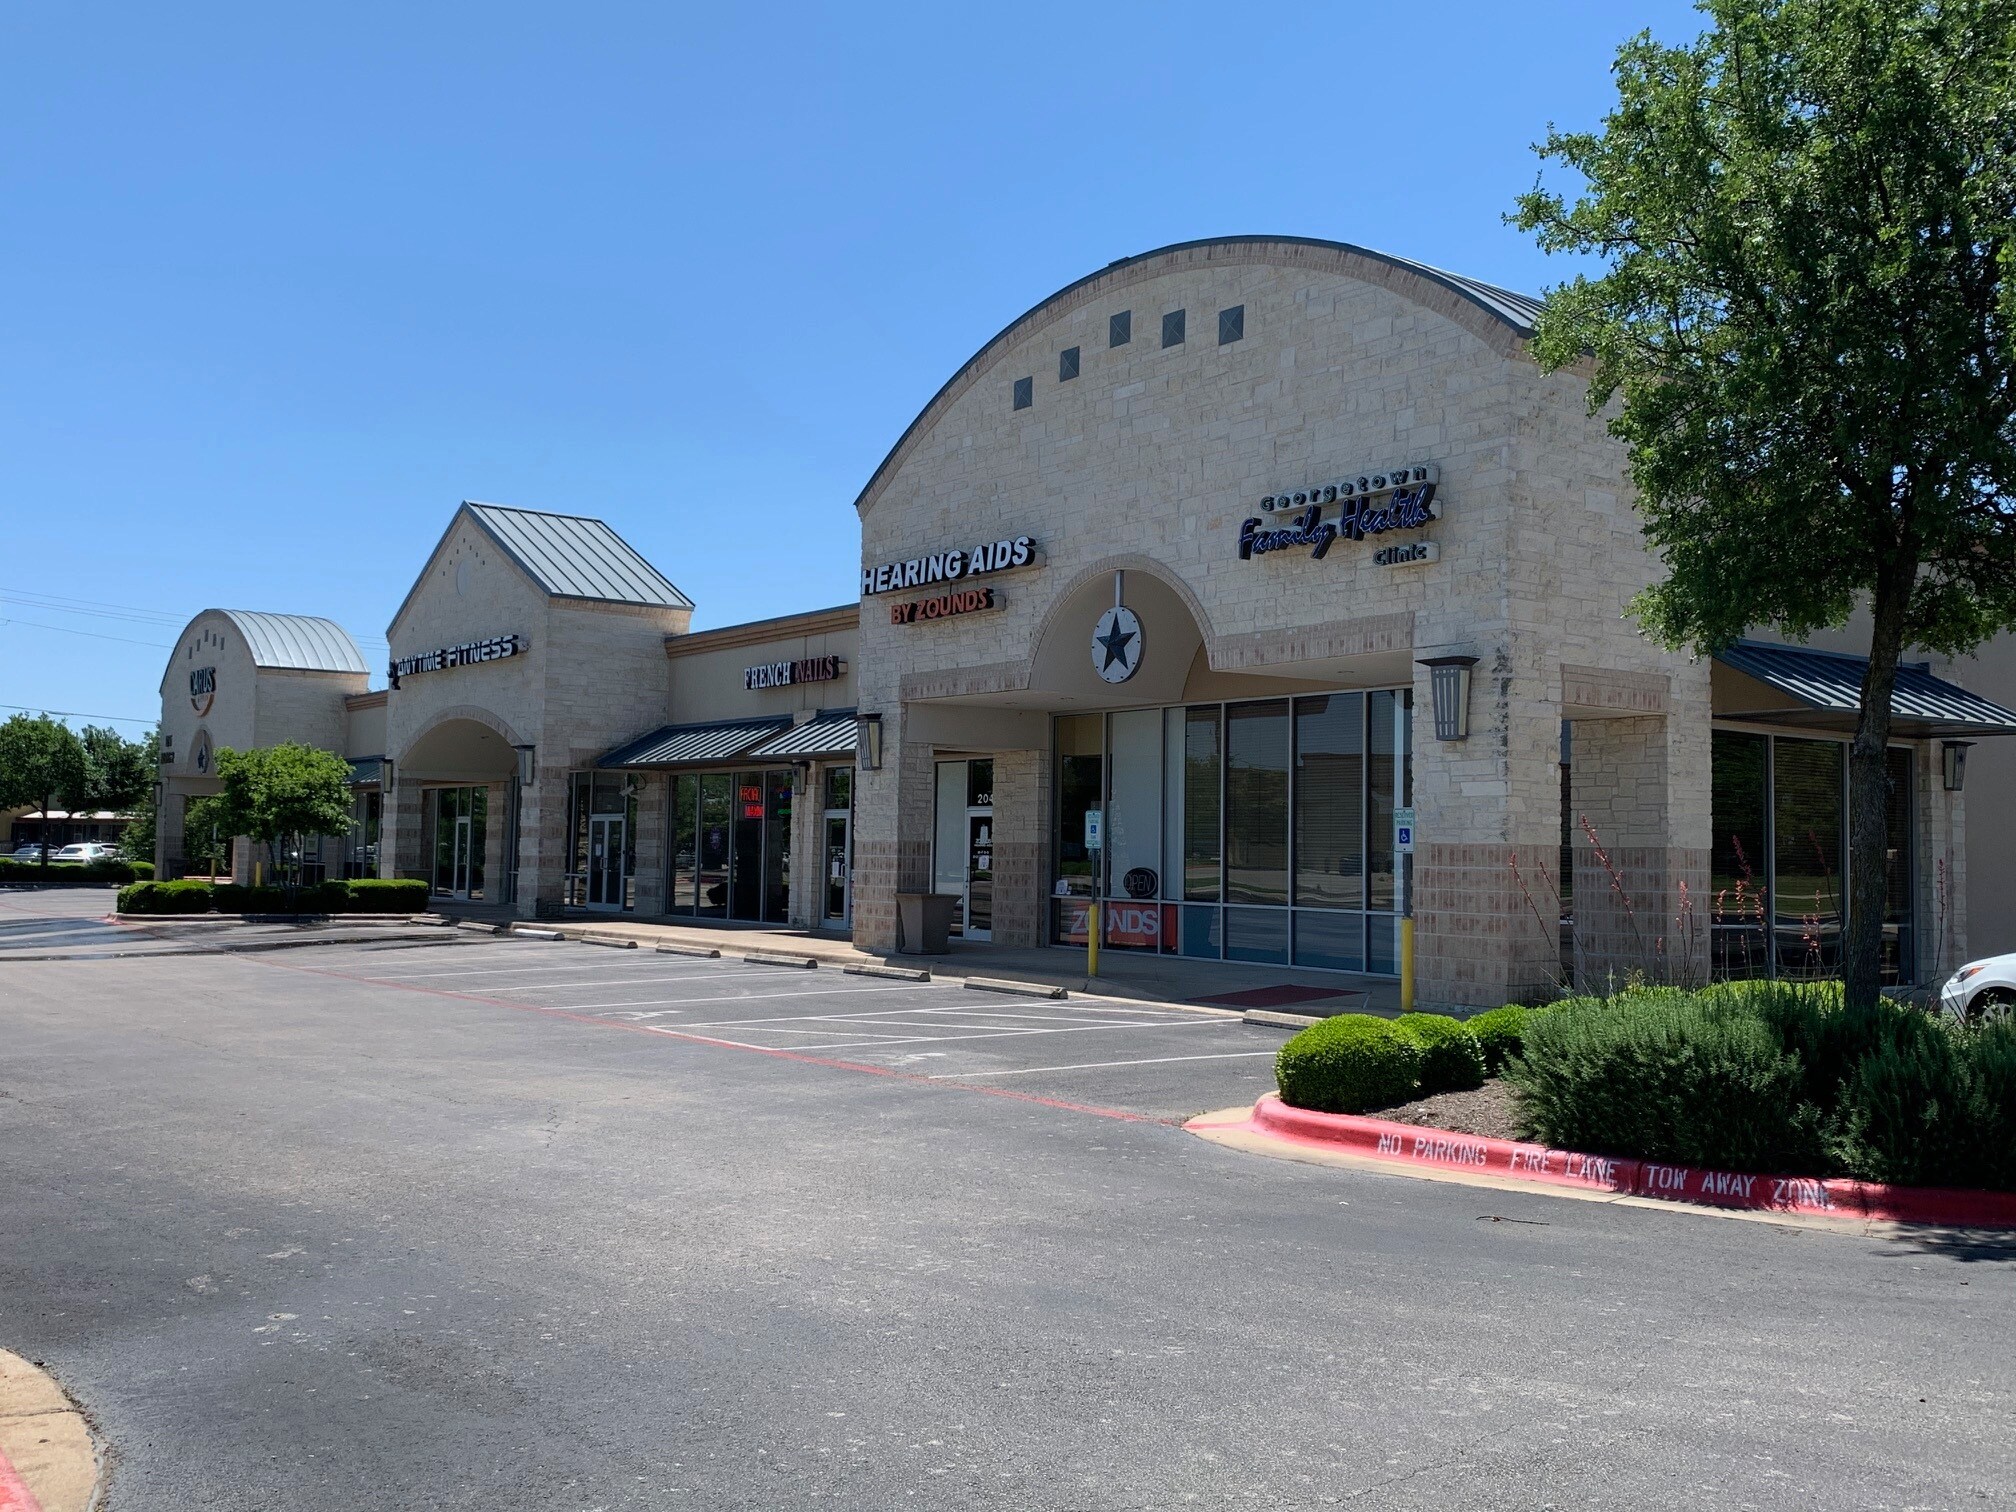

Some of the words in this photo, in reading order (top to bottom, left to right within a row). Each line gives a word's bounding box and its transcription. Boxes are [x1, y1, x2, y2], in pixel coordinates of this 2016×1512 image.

[1260, 466, 1427, 512] Georgetown
[1239, 505, 1336, 560] Family
[1341, 482, 1433, 541] Health
[861, 550, 963, 595] HEARING
[967, 536, 1031, 575] AIDS
[891, 604, 912, 625] BY
[914, 587, 989, 621] ZOUNDS
[397, 649, 444, 677] ANYTIME
[446, 634, 516, 668] FITNESS
[743, 662, 792, 690] FRENCH
[795, 655, 836, 683] NAILS
[1125, 873, 1152, 892] OPEN
[1071, 909, 1158, 935] ZNDS
[1377, 1132, 1402, 1156] NO
[1412, 1137, 1487, 1166] PARKING
[1509, 1149, 1553, 1175] FIRE
[1565, 1153, 1621, 1184] LANE
[1647, 1165, 1688, 1190] TOW
[1701, 1172, 1756, 1199] AWAY
